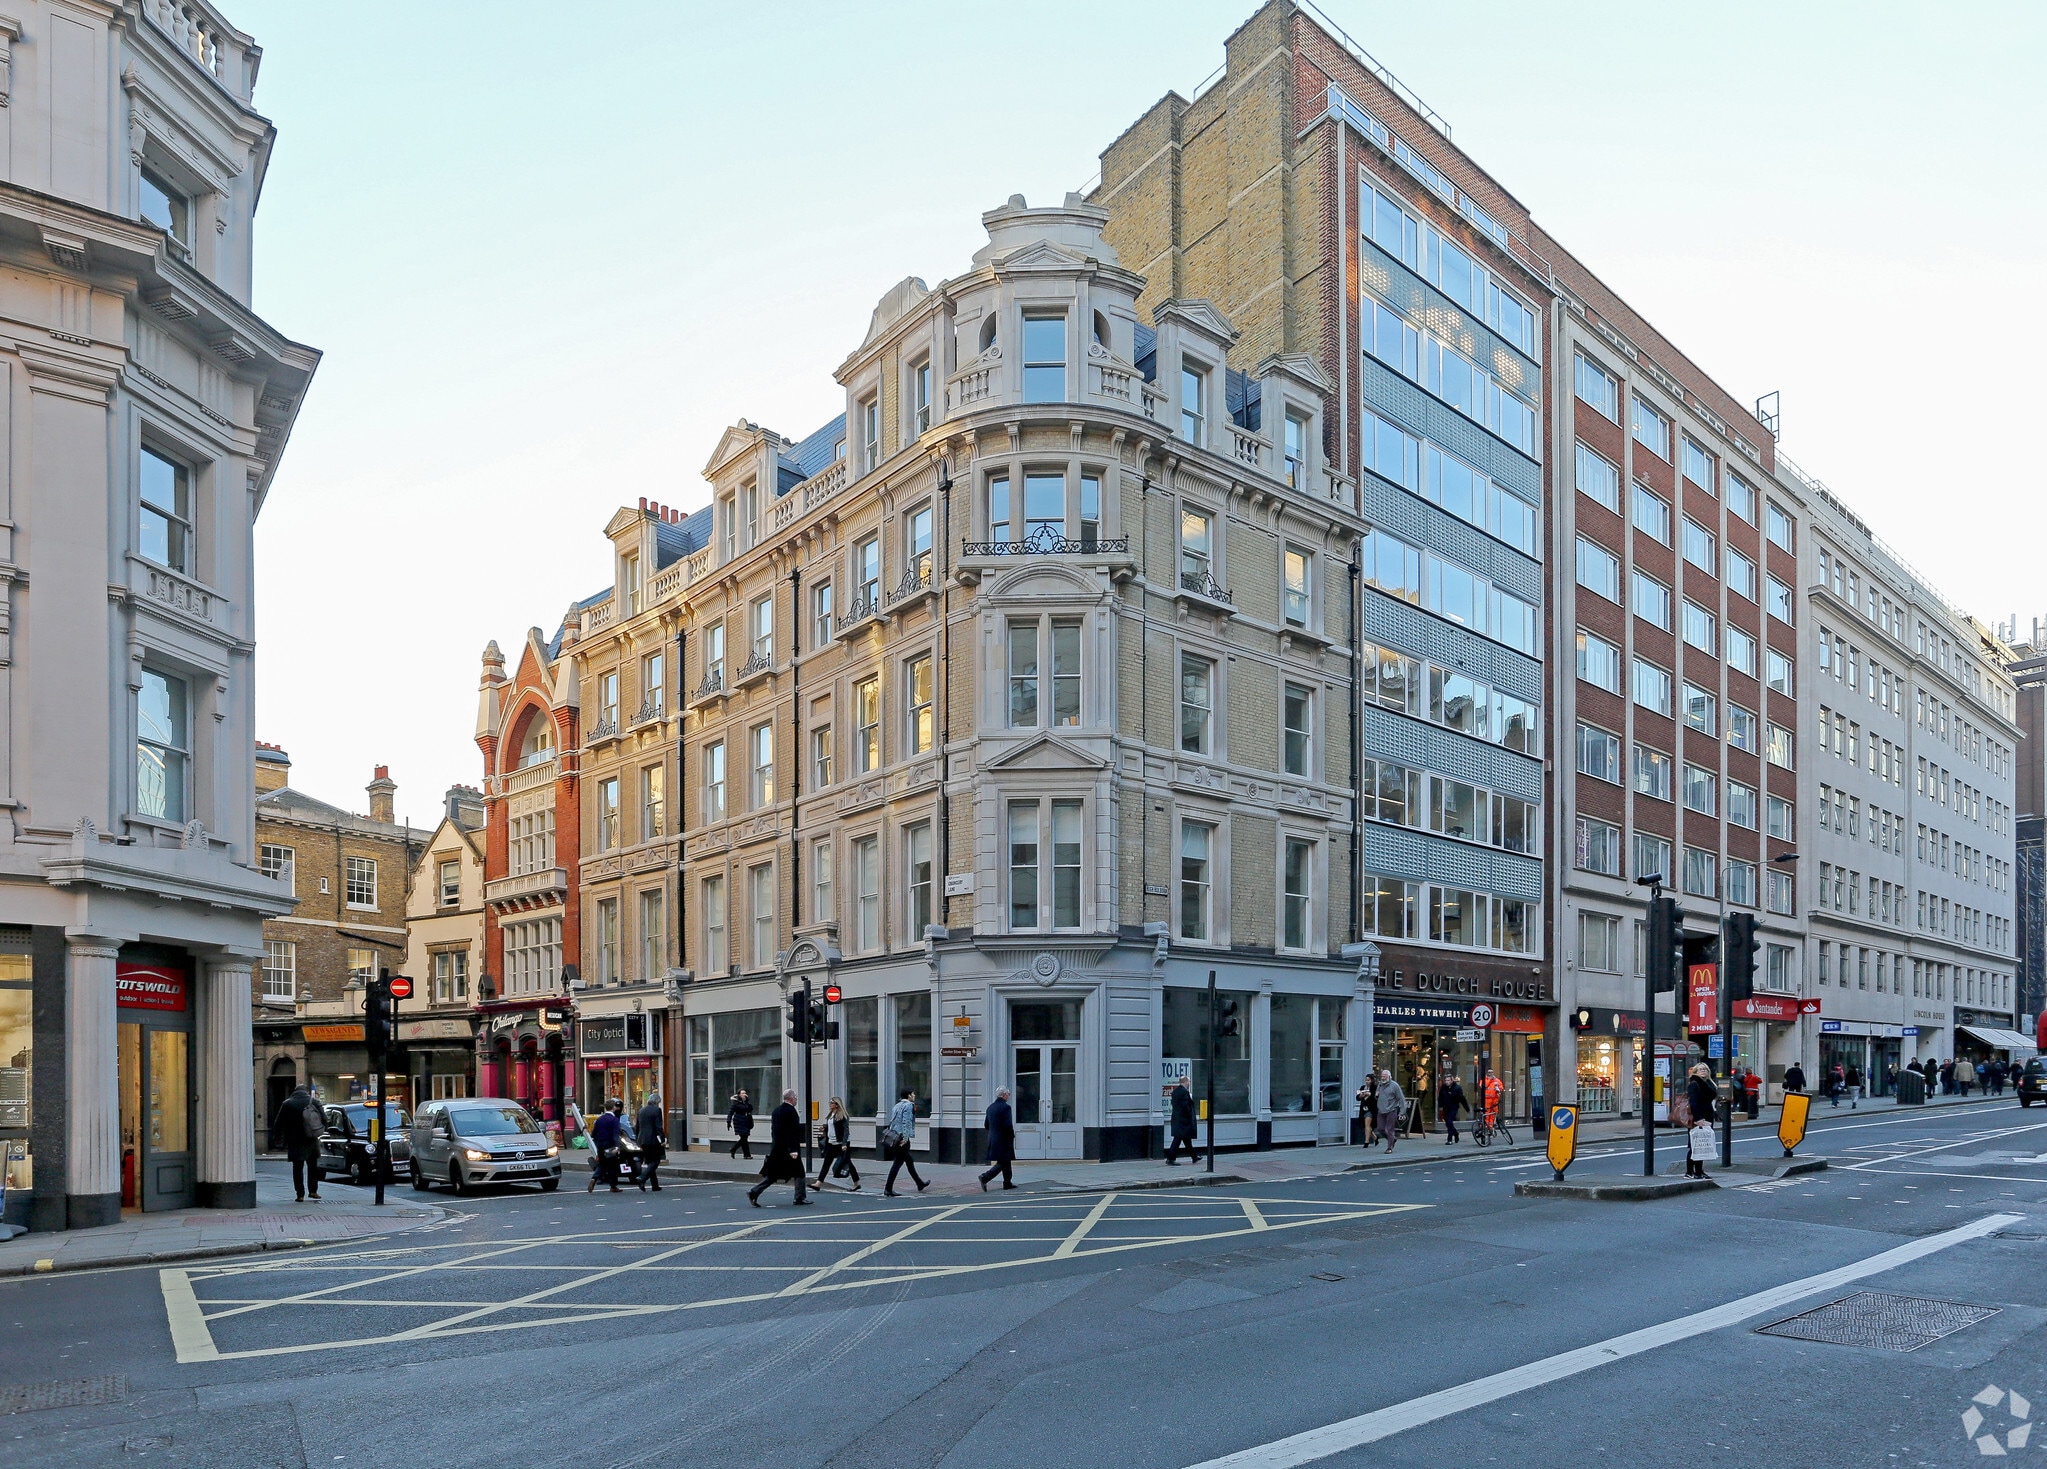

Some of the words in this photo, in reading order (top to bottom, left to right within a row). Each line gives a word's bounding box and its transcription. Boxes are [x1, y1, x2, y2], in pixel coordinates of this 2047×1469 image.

[1376, 969, 1403, 988] HE
[1418, 972, 1480, 994] DUTCH
[1492, 979, 1545, 999] HOUSE
[1755, 1000, 1784, 1015] Santander
[1474, 1010, 1490, 1021] 20
[1620, 1013, 1646, 1031] Rynes
[588, 1029, 602, 1040] City
[603, 1028, 624, 1040] Optici
[1162, 1062, 1173, 1078] TO
[1175, 1062, 1189, 1077] LET
